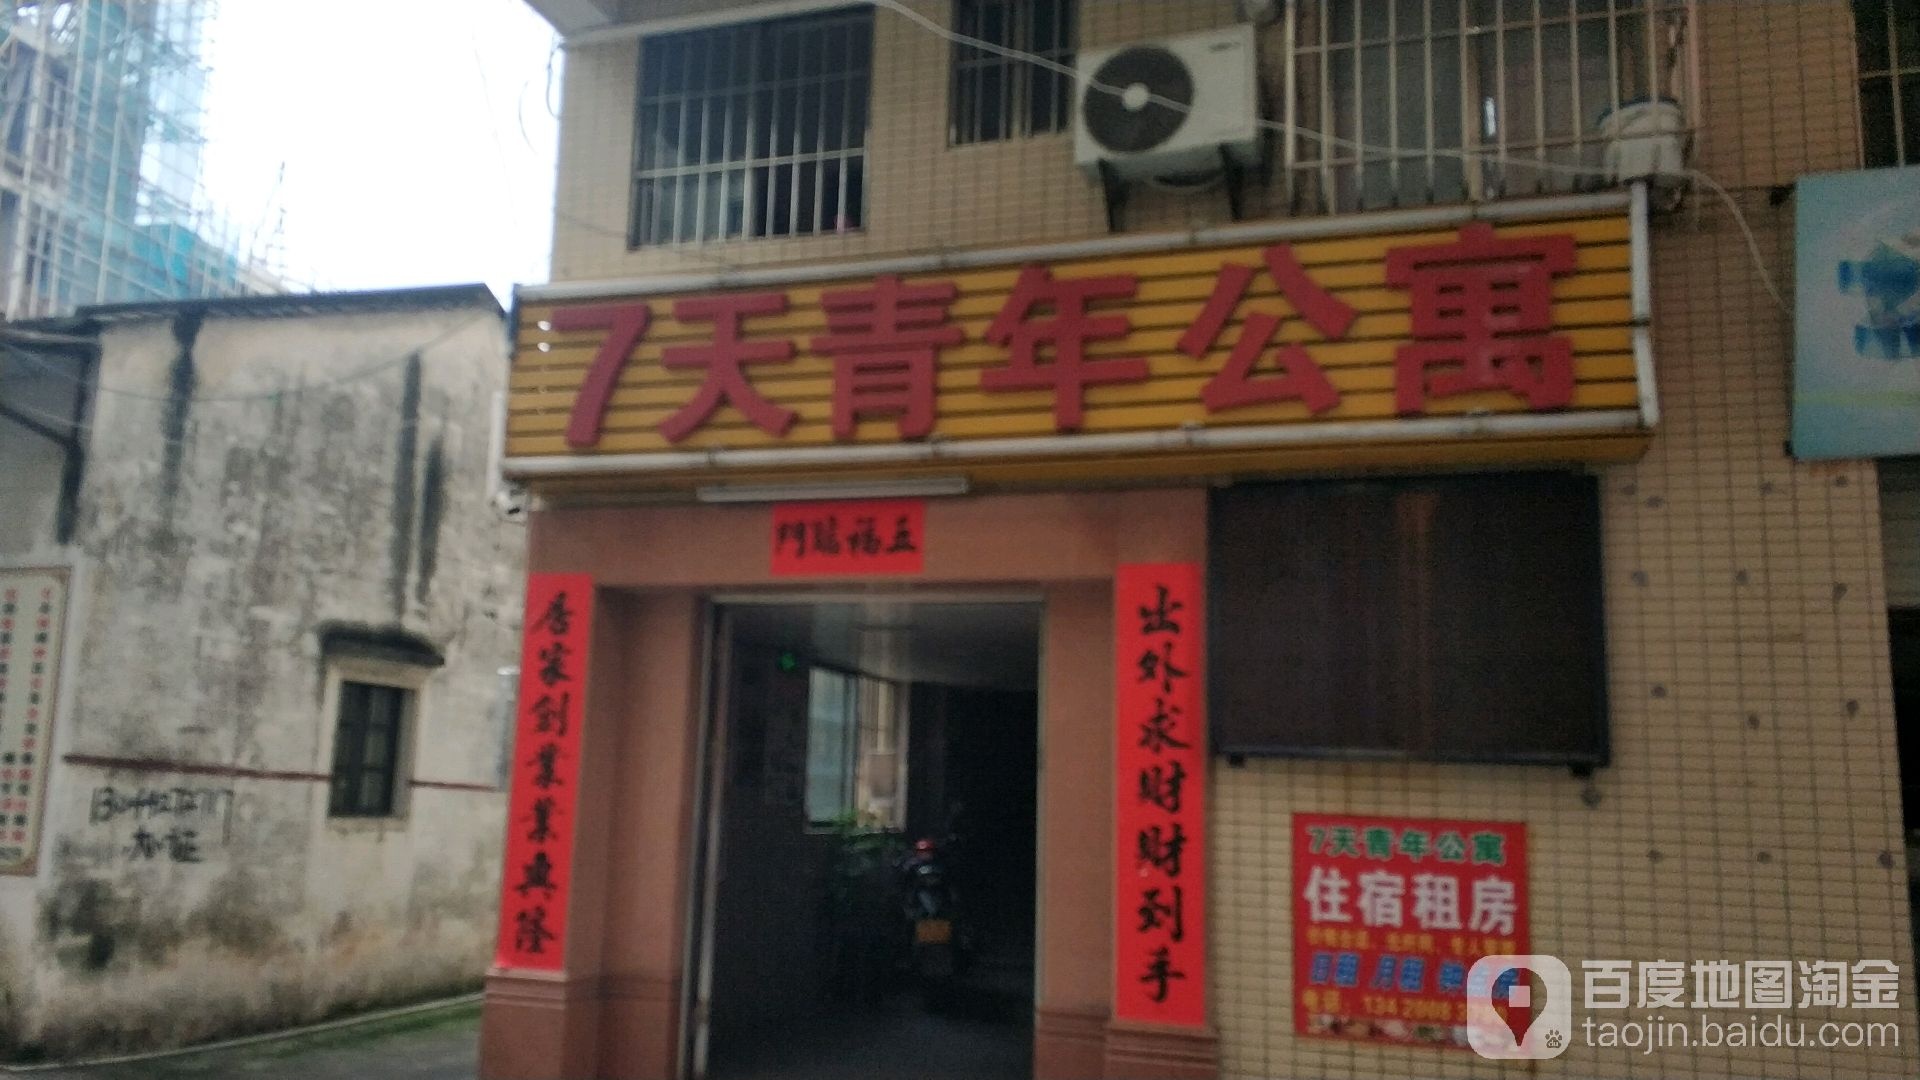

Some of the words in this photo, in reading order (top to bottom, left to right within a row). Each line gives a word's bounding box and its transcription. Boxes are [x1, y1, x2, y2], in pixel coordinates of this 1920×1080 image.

[551, 224, 1576, 447] 7天青年公寓
[1136, 583, 1191, 1004] 出外求財財到手
[1306, 826, 1506, 866] 7天青年公寓
[1303, 866, 1517, 936] 住宿租房
